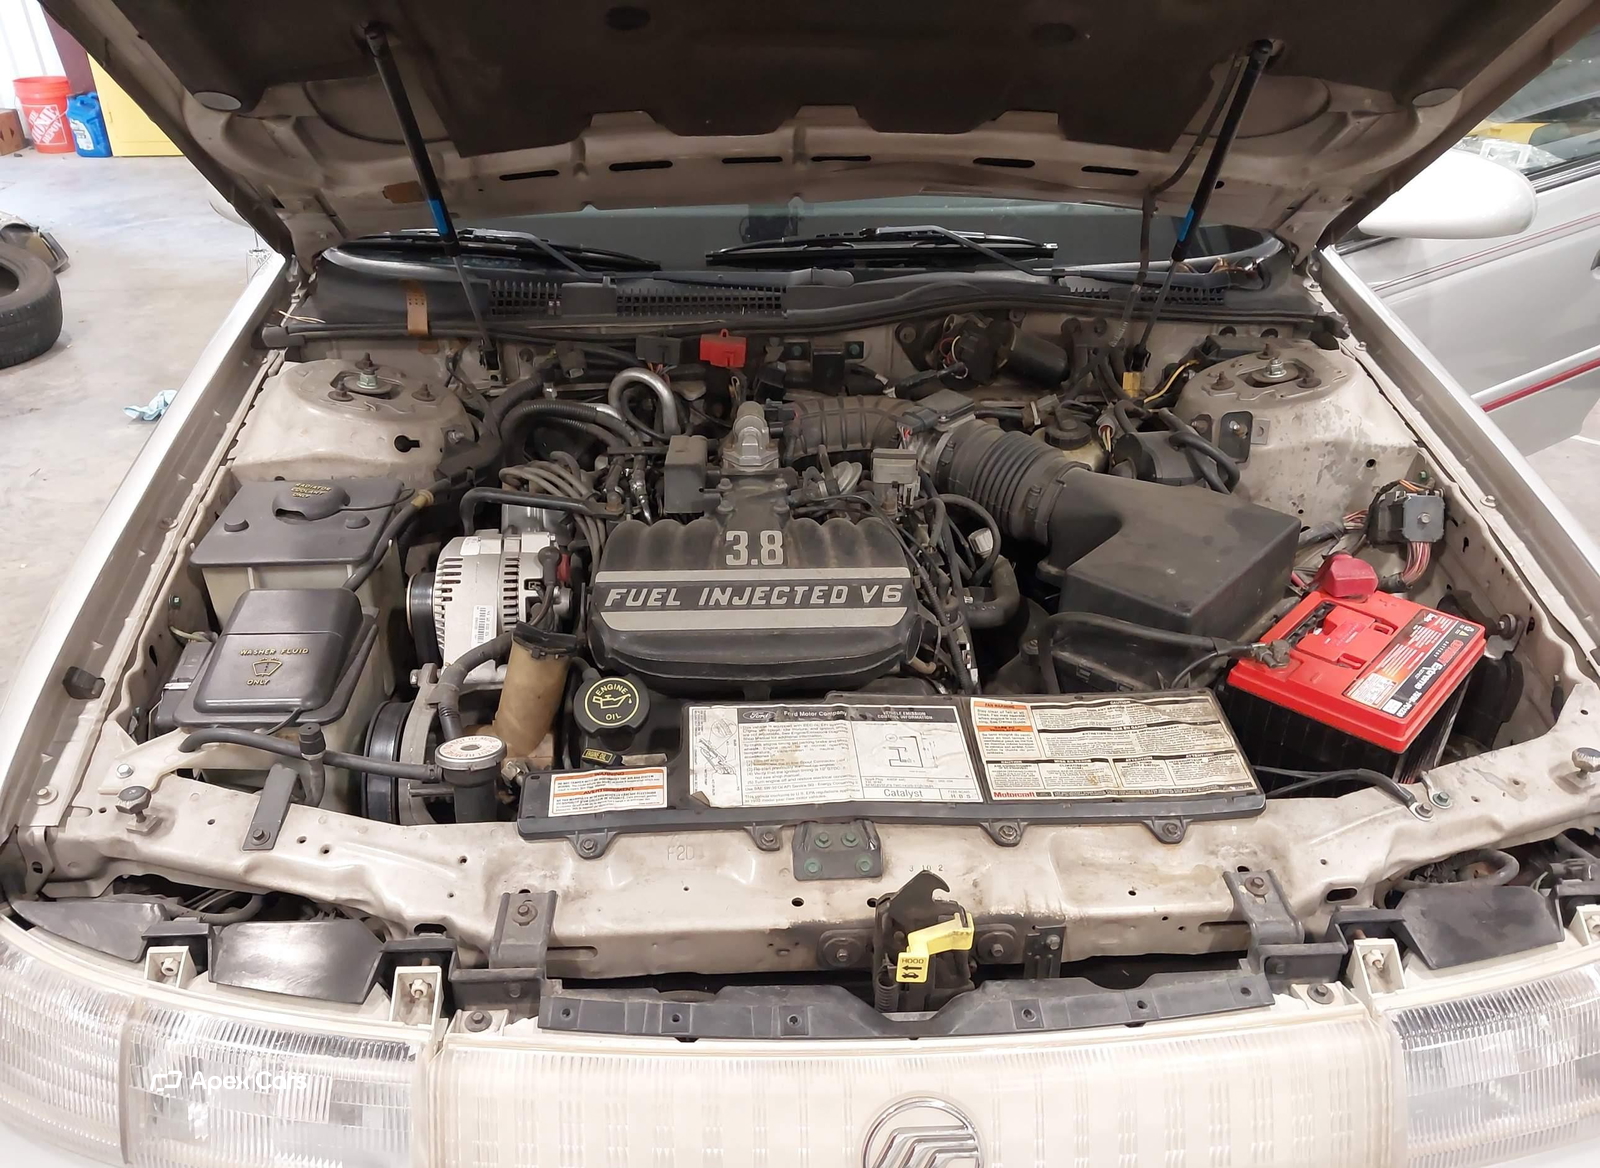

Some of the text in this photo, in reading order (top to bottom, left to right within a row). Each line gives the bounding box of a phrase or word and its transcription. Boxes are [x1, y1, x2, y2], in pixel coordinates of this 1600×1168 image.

[295, 483, 332, 491] RADIATOR
[725, 530, 784, 565] 3.8
[604, 584, 903, 606] FUEL INJECTED V6
[595, 684, 628, 696] ENGINE
[884, 789, 923, 798] Catalyst
